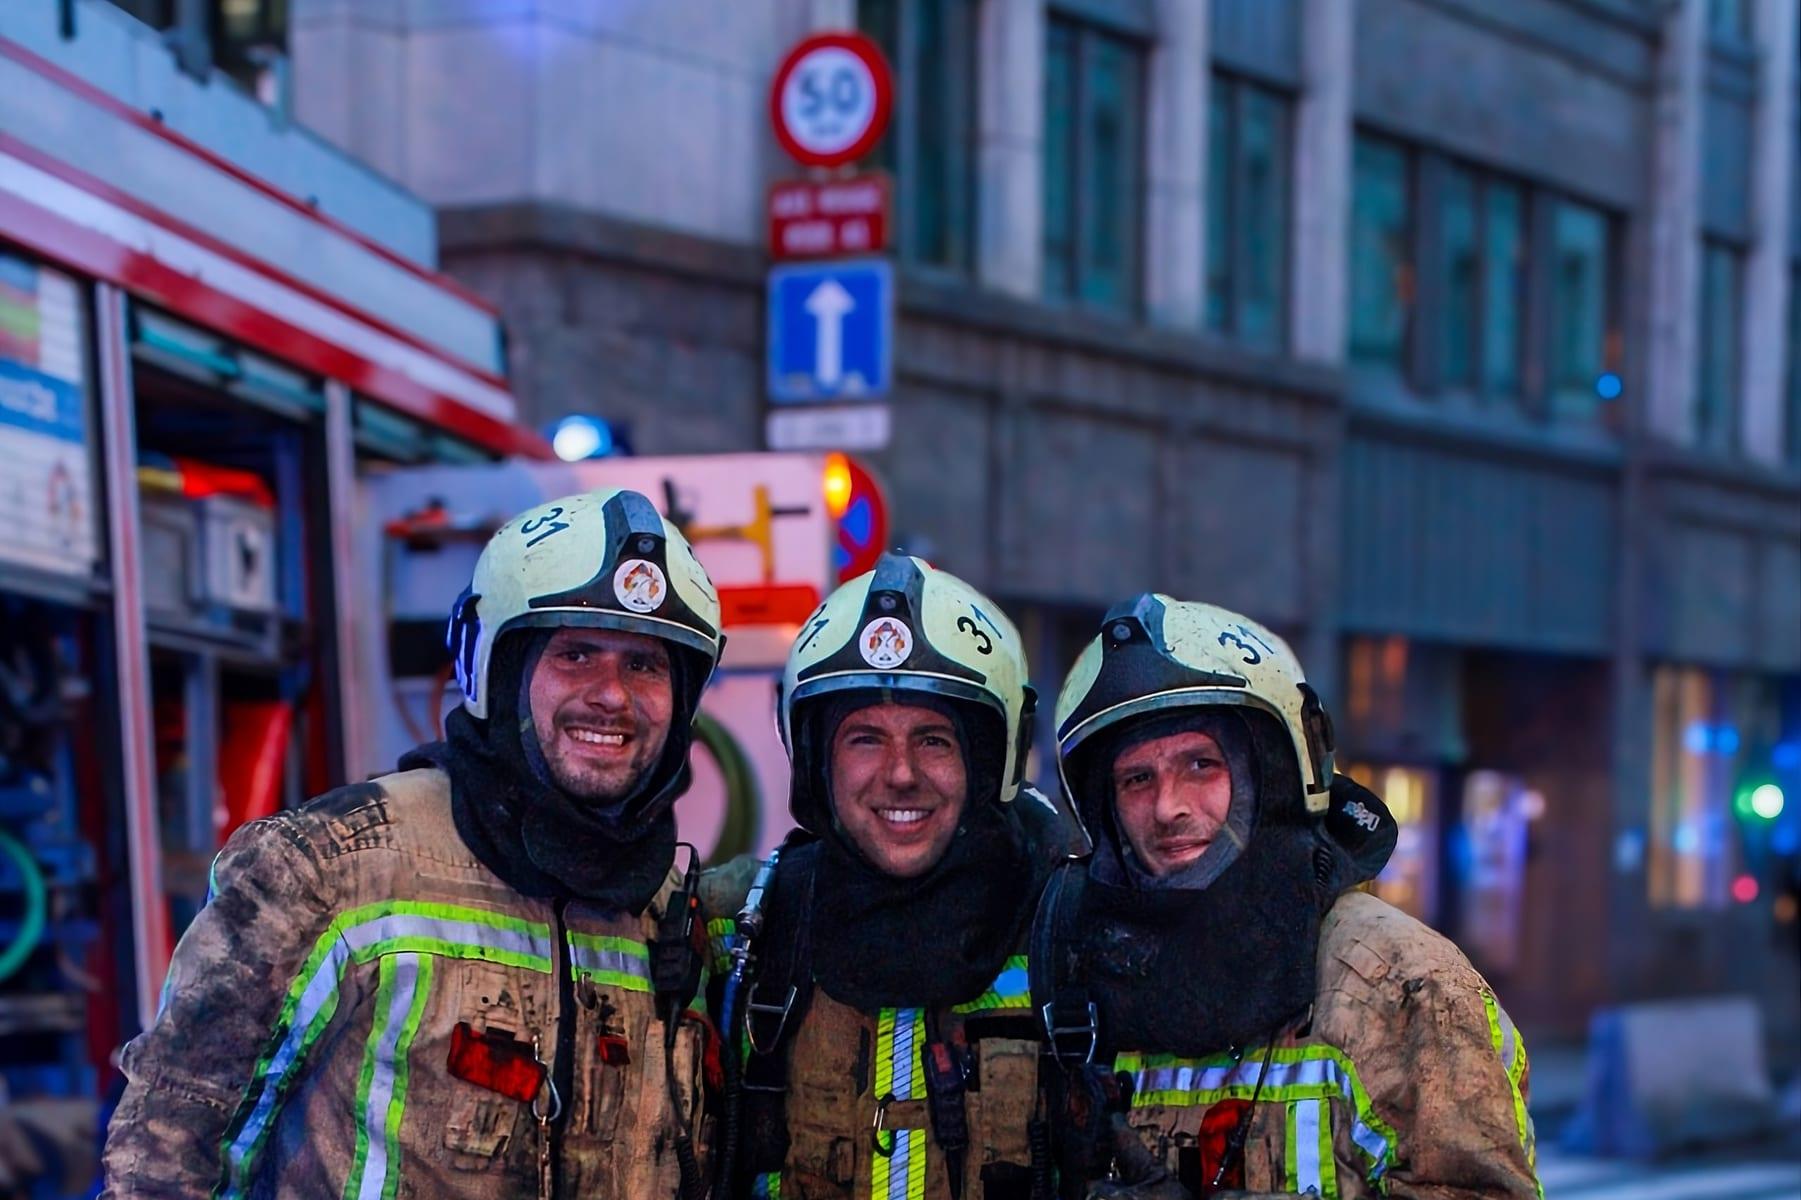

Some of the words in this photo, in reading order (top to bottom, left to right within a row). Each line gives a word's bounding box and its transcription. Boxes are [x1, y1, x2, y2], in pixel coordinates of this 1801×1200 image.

[799, 67, 861, 117] 50
[521, 507, 569, 548] 31
[957, 603, 1002, 655] 31
[1218, 624, 1274, 665] 31
